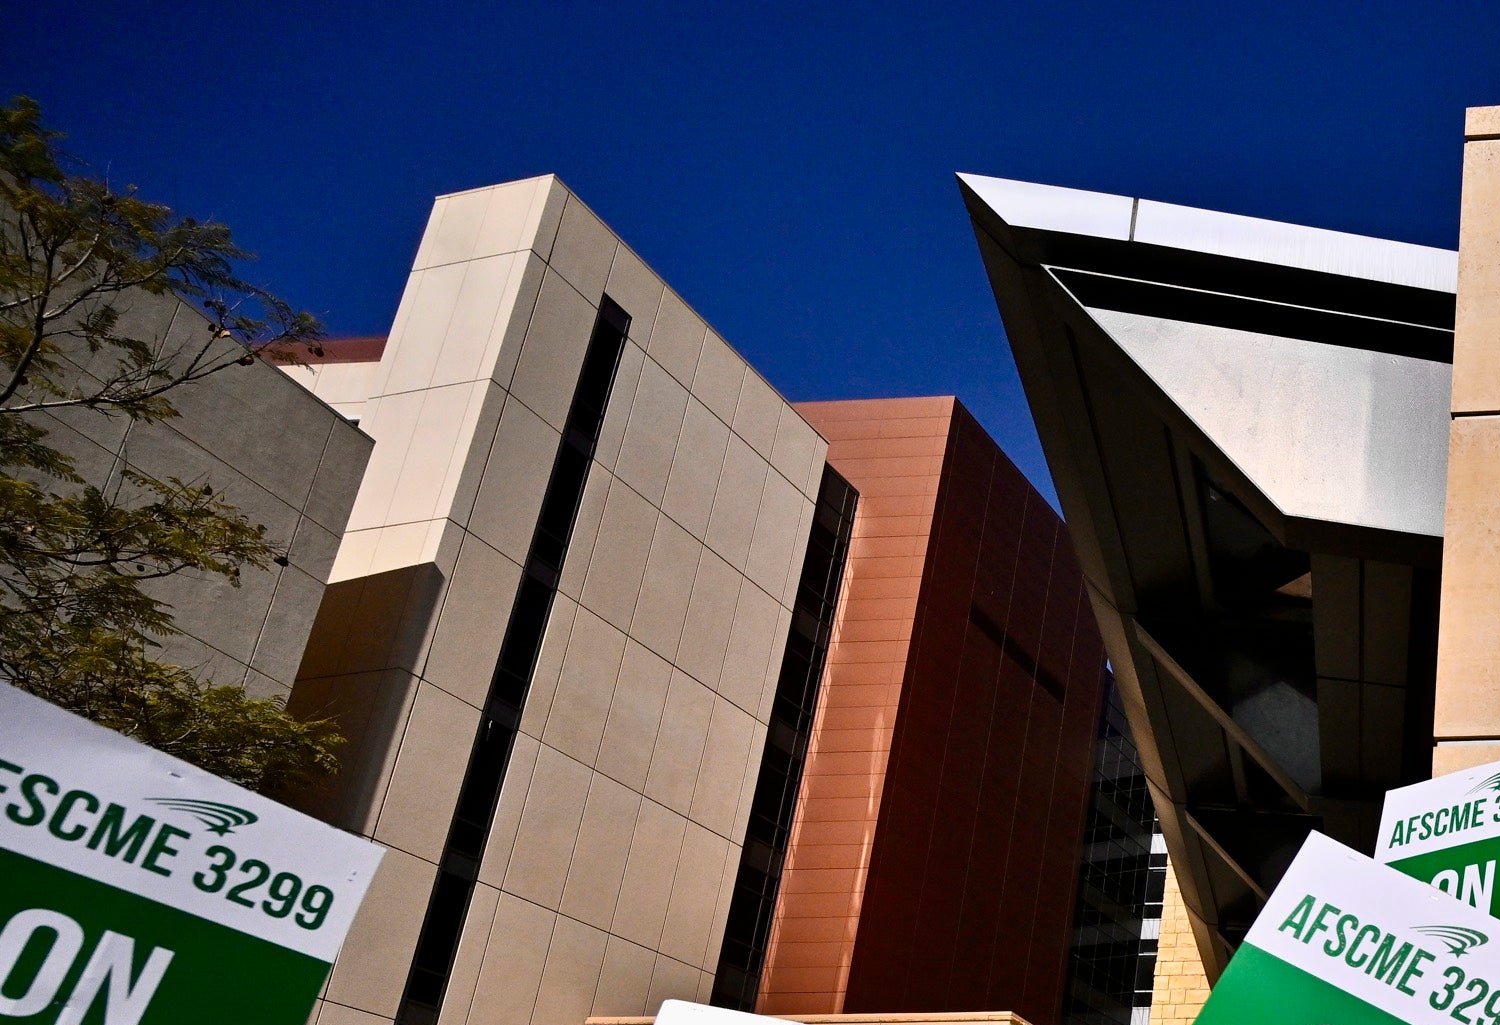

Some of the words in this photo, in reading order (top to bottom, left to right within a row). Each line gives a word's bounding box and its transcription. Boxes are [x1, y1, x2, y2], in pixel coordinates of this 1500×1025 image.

[1389, 798, 1487, 849] AFSCME
[192, 845, 334, 930] 3299
[1278, 893, 1436, 996] AFSCME
